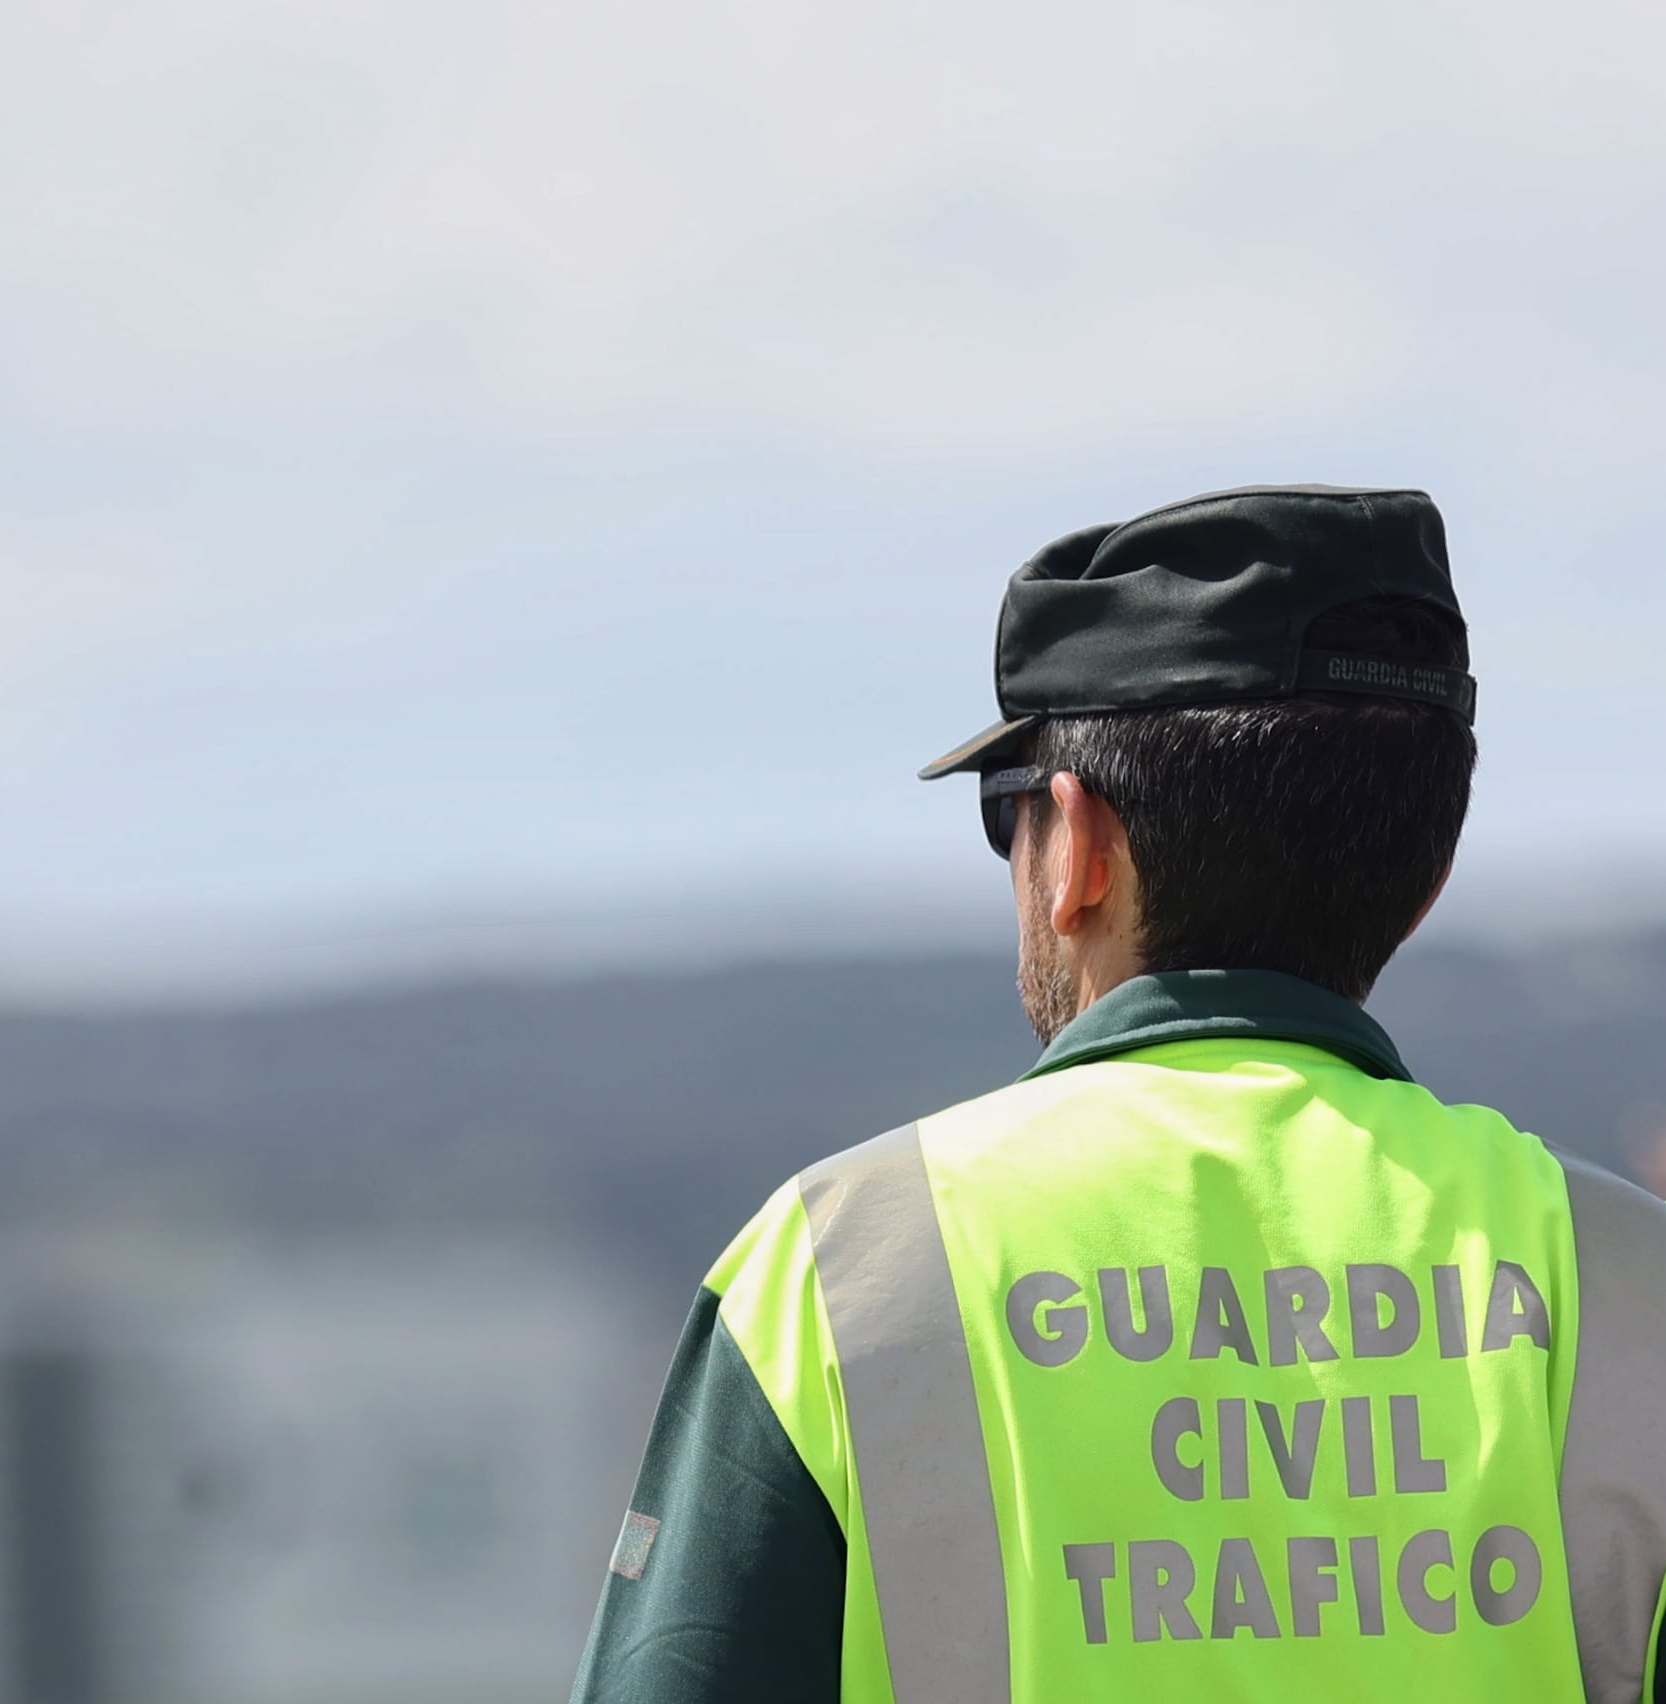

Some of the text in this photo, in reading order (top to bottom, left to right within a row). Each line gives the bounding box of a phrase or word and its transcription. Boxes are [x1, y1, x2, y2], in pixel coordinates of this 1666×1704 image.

[1328, 656, 1449, 697] GUARDIA CIVIL
[1004, 1259, 1552, 1368] GUARDIA
[1150, 1394, 1448, 1502] CIVIL
[1062, 1524, 1543, 1645] TRAFICO
